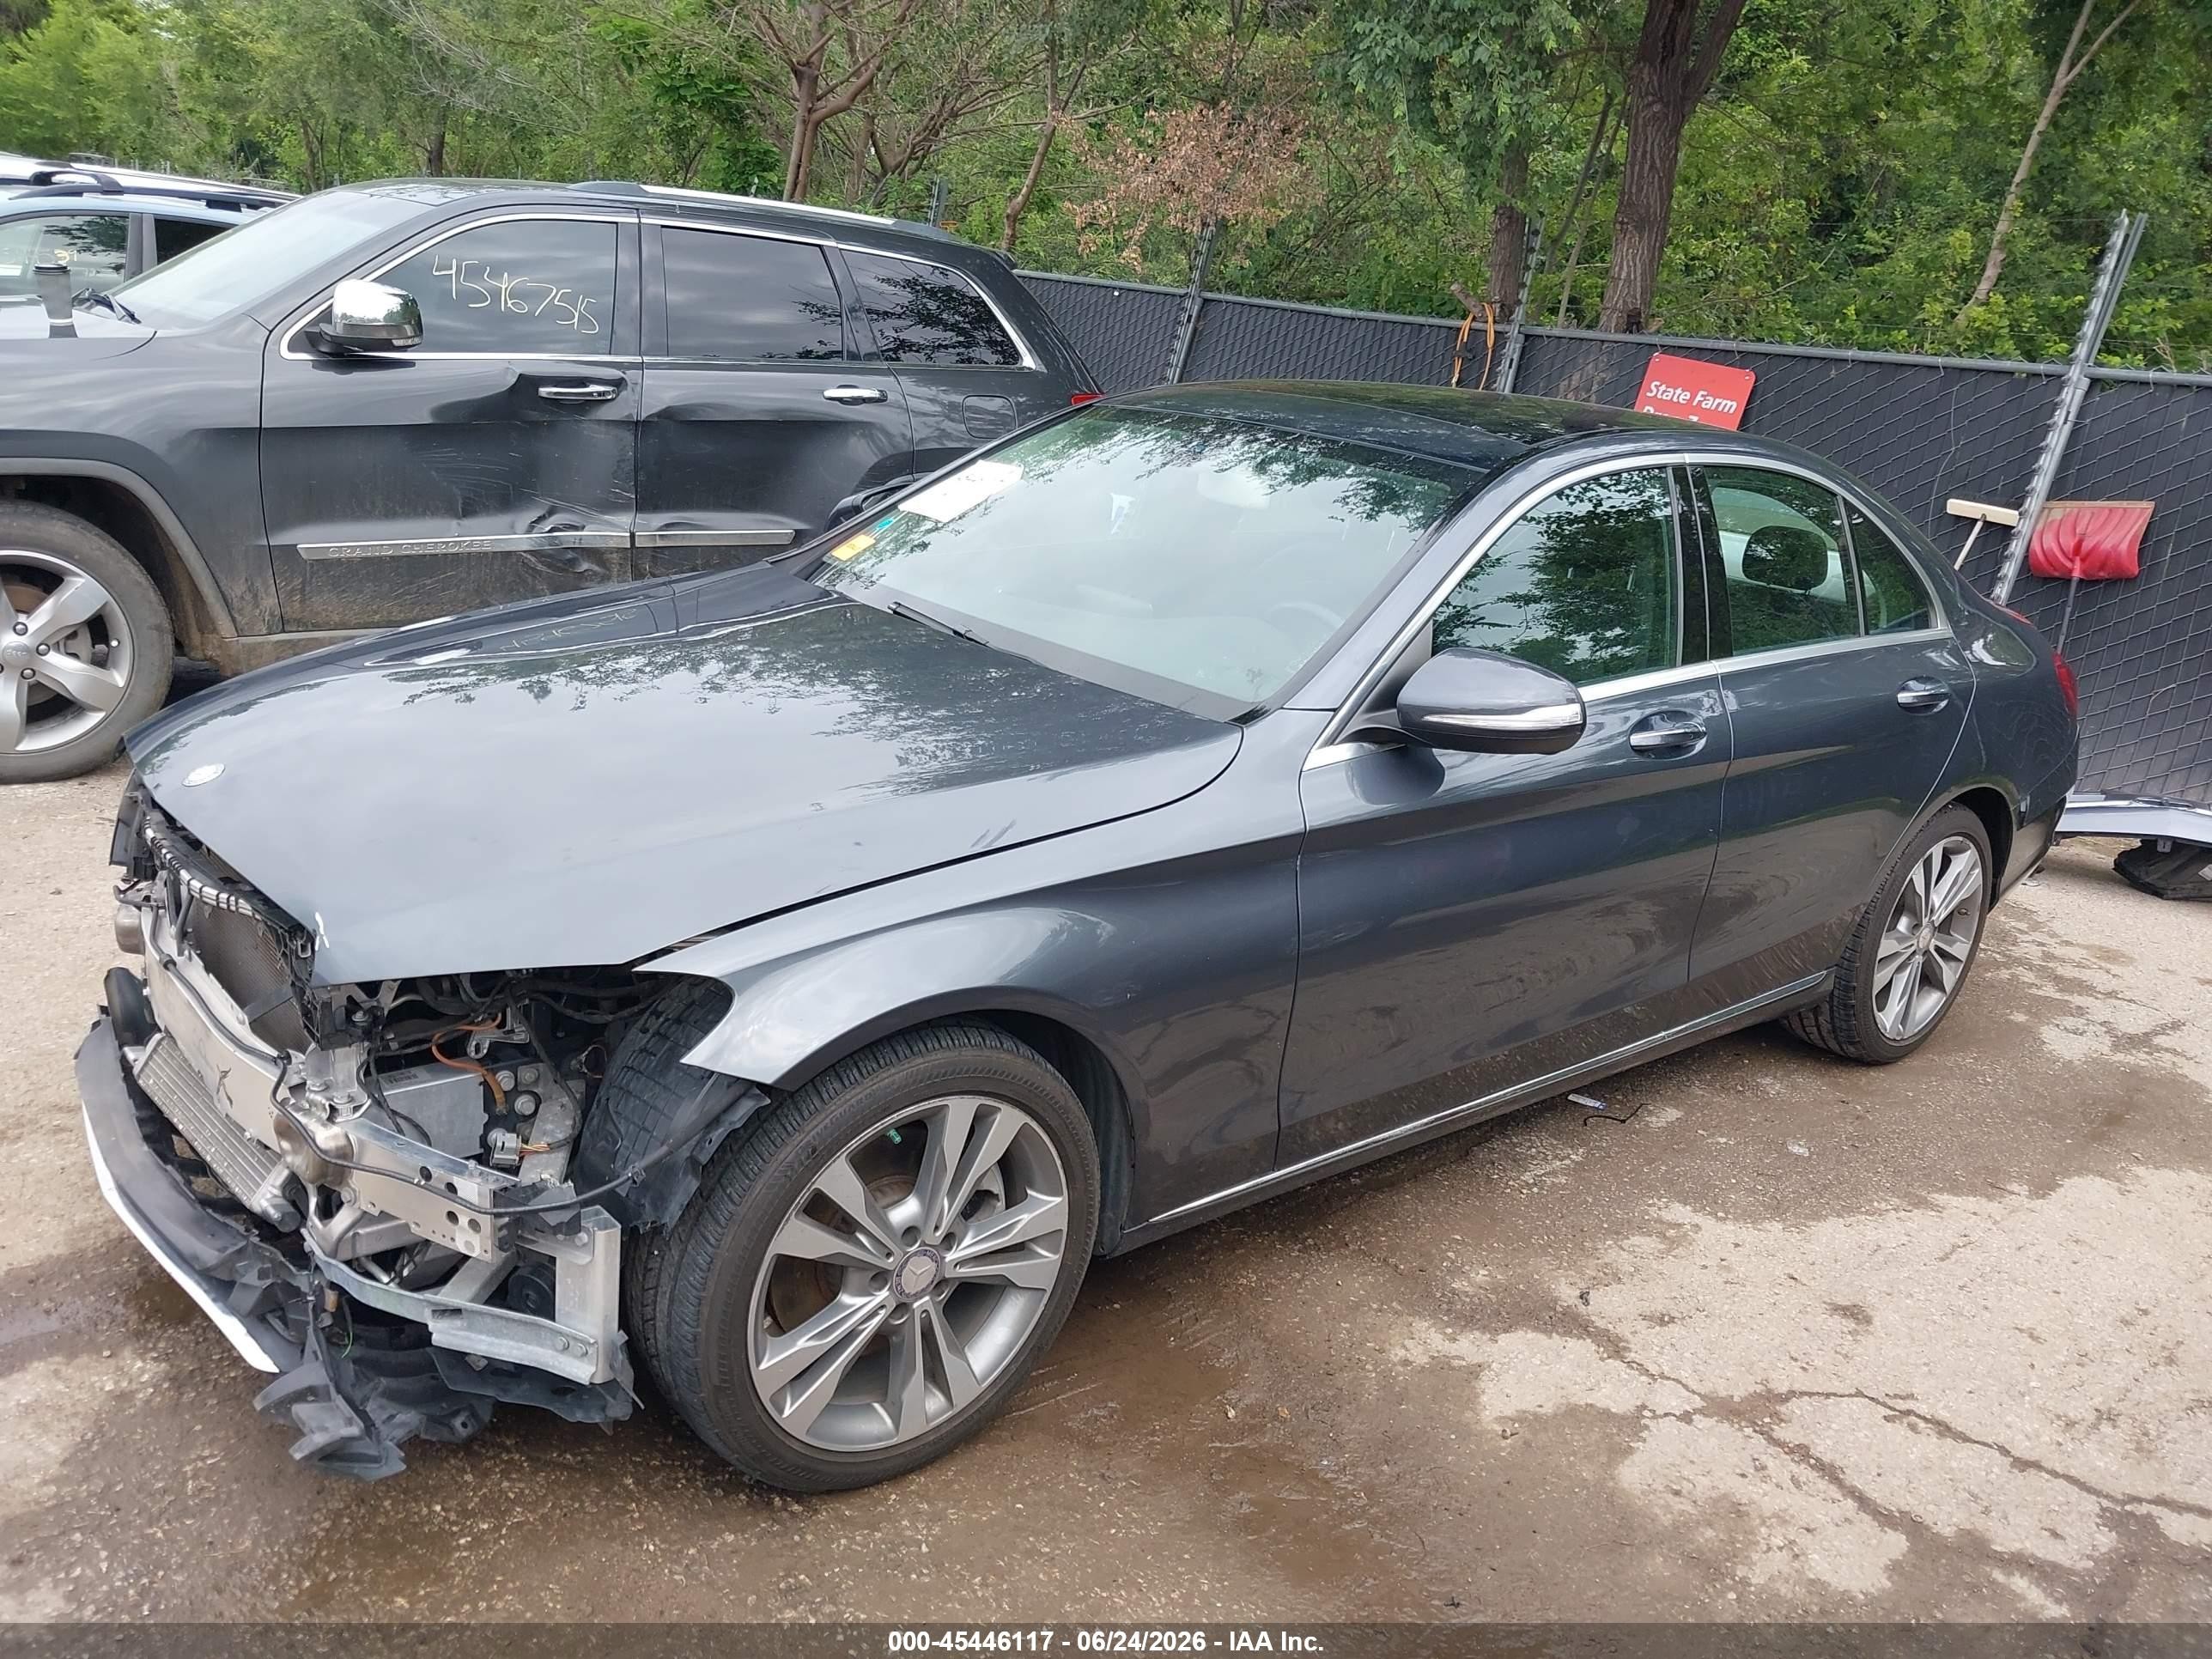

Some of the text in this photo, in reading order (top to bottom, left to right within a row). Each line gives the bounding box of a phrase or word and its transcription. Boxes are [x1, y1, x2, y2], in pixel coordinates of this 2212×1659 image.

[1646, 380, 1691, 404] State
[1692, 390, 1737, 414] Farm
[329, 540, 493, 557] GRAND CHEROKEE
